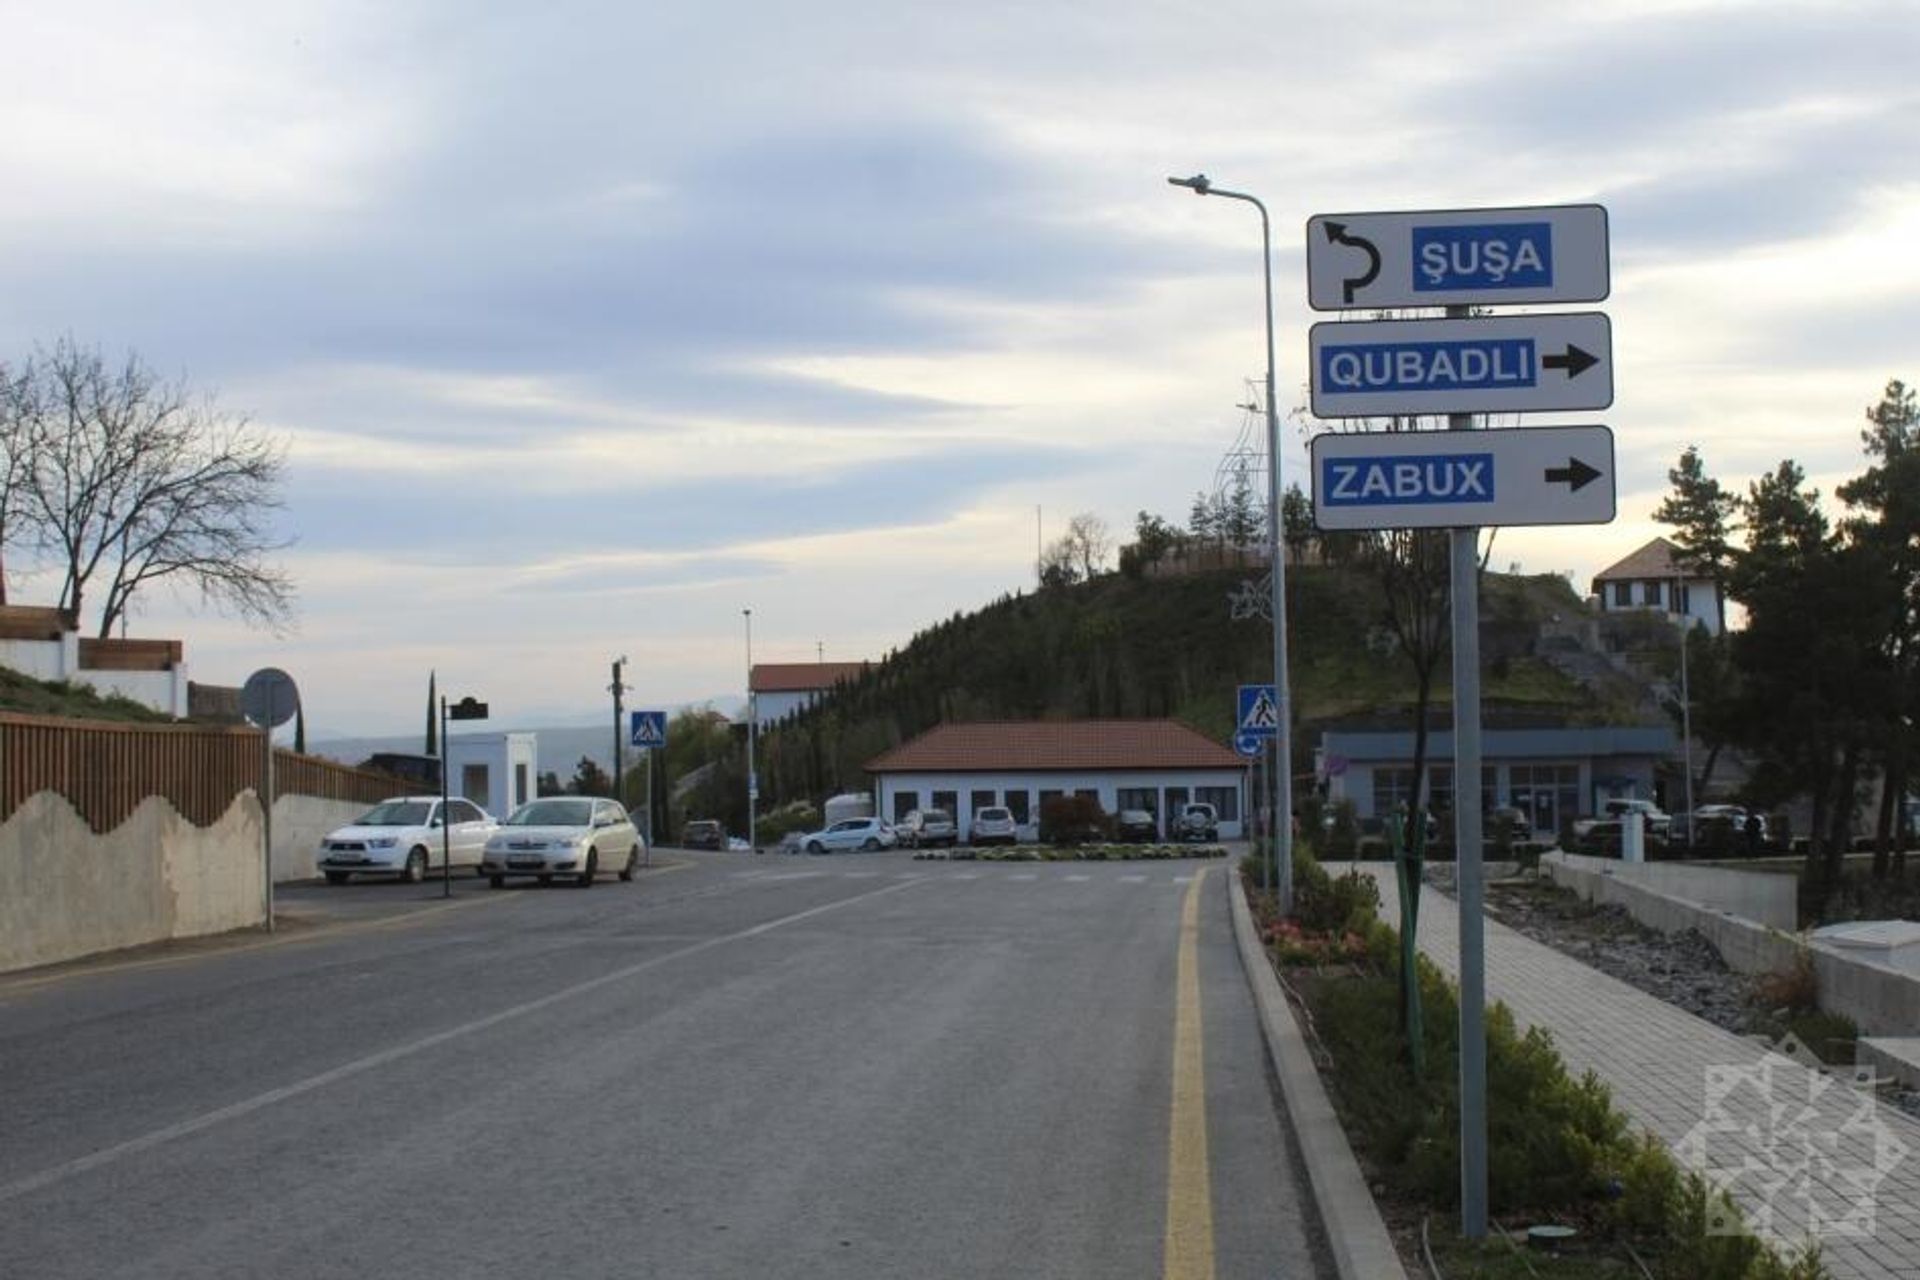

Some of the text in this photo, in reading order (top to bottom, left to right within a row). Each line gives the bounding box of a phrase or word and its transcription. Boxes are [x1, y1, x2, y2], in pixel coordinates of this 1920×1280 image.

[1420, 240, 1543, 284] ŞUŞA
[1329, 347, 1529, 387] QUBADLI
[1332, 462, 1486, 499] ZABUX
